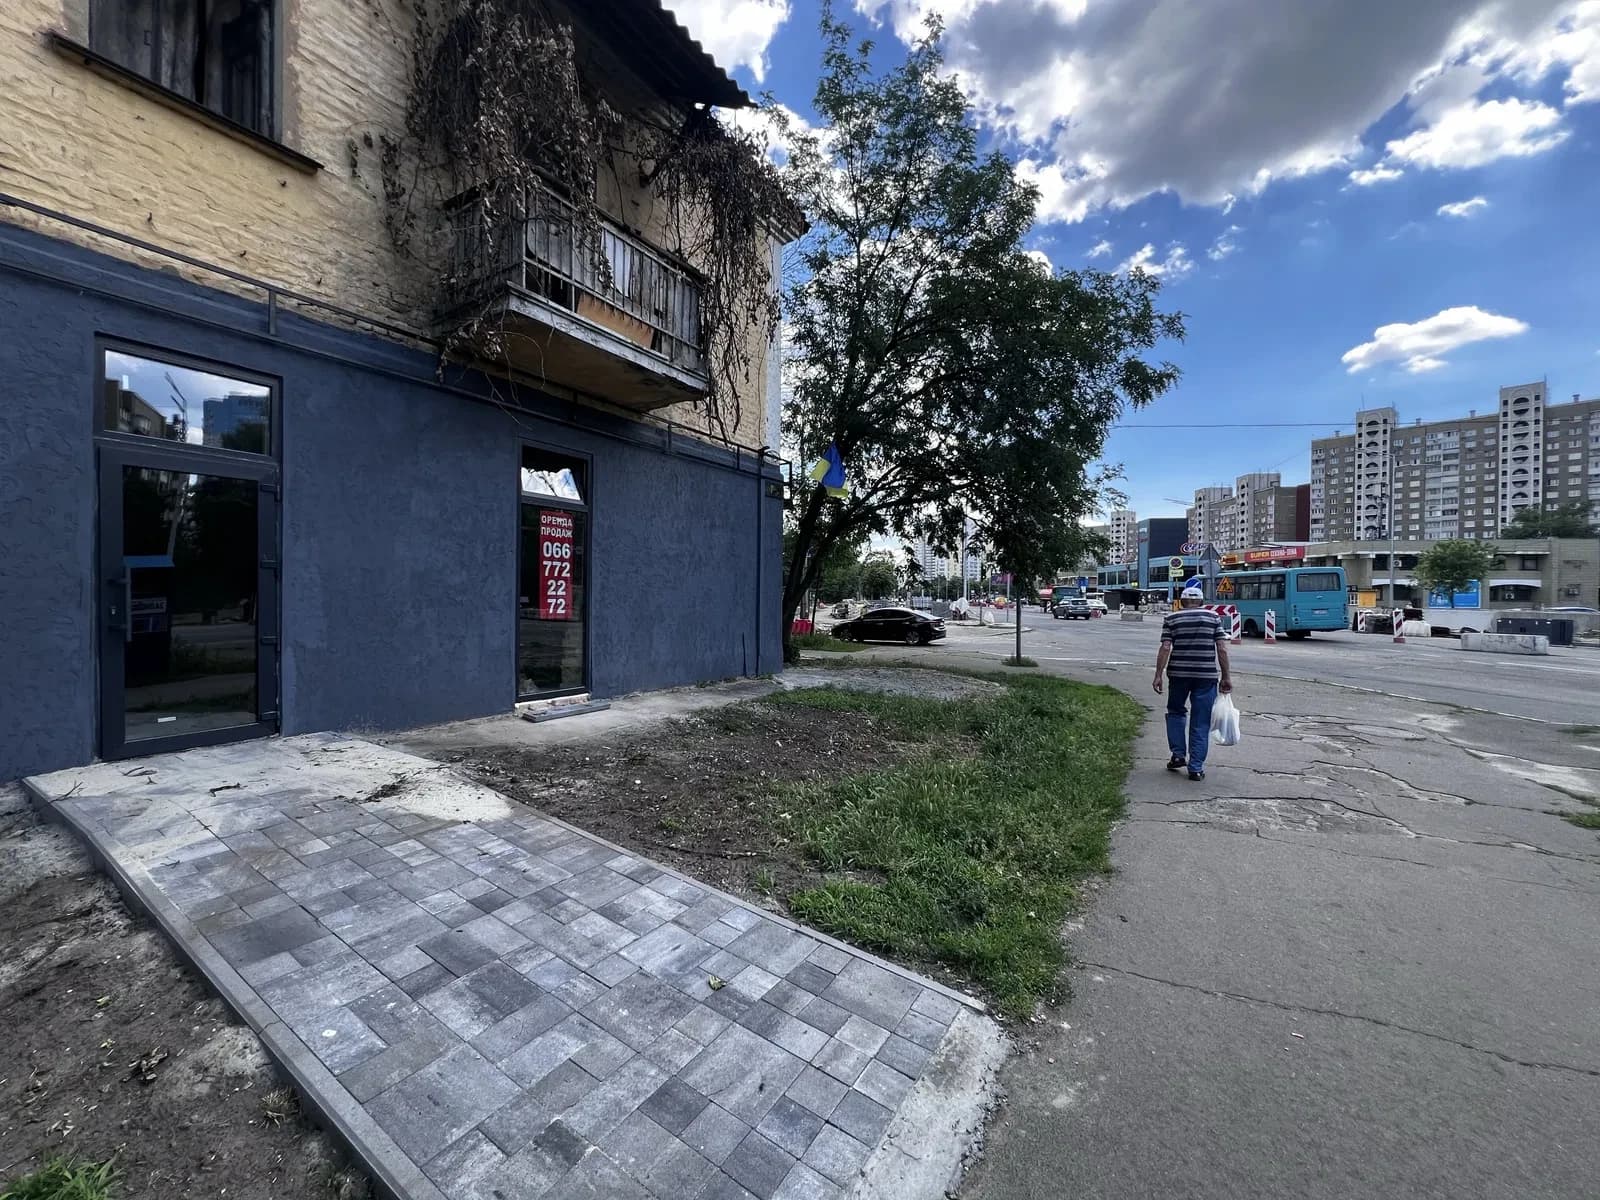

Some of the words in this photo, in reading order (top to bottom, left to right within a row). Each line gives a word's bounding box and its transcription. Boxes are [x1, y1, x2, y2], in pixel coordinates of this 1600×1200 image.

[541, 515, 572, 526] ОРЕНДА
[541, 527, 572, 538] ПРОДАЖ
[542, 541, 571, 558] 066
[542, 560, 570, 576] 772
[547, 580, 566, 596] 22
[546, 598, 566, 614] 72
